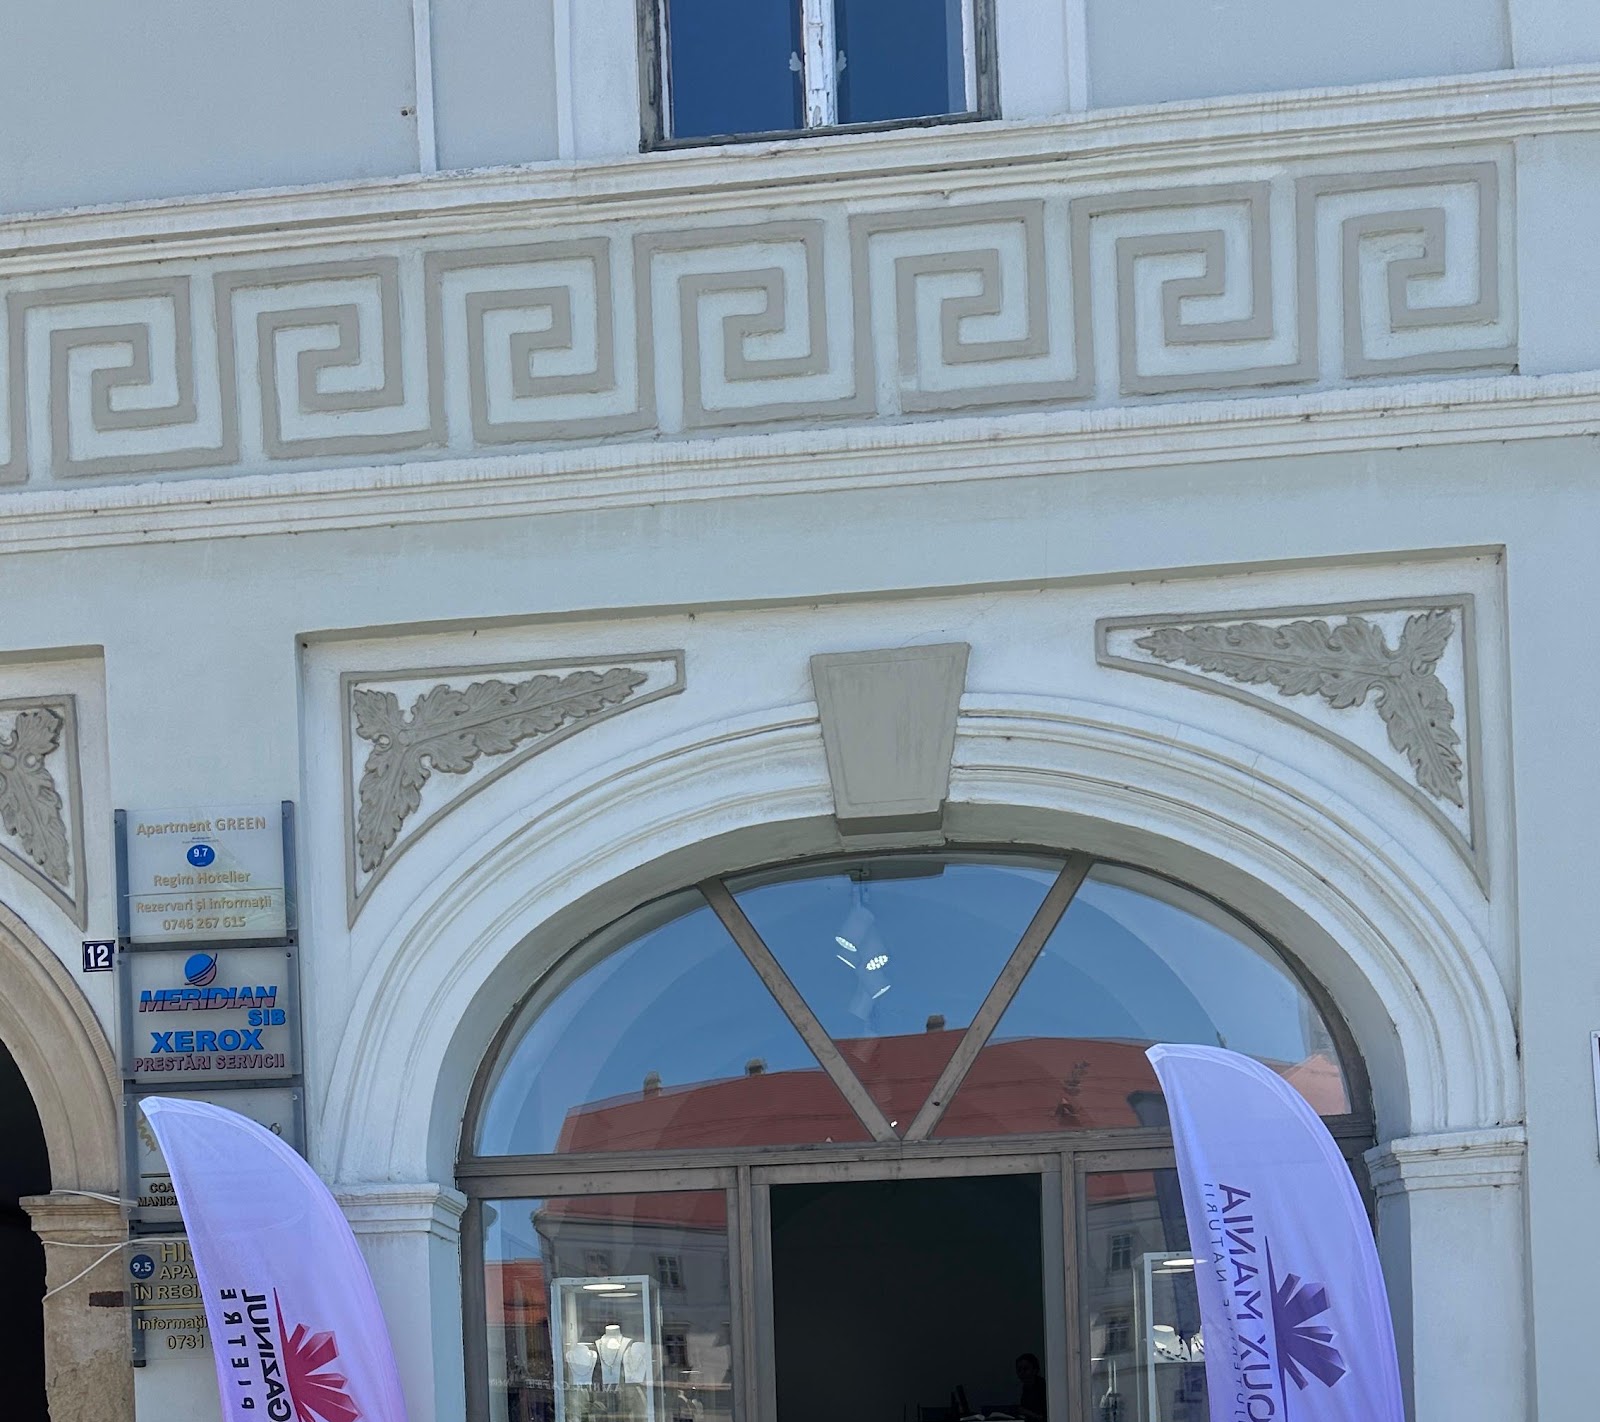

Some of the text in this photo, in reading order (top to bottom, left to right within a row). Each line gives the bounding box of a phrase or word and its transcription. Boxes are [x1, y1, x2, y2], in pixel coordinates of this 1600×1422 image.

[136, 817, 266, 838] Apartment GREEN
[193, 847, 209, 858] 9.7
[153, 871, 251, 888] Regim Hotelier
[136, 899, 193, 913] Rezervari
[162, 917, 194, 931] 0746
[223, 915, 246, 928] 615
[87, 944, 110, 968] 12
[138, 985, 278, 1012] MERIDIAN
[247, 1008, 287, 1027] SIB
[150, 1028, 265, 1053] XEROX
[133, 1052, 285, 1072] PRESTĂRI SERVICII
[161, 1242, 194, 1263] HI
[132, 1262, 152, 1273] 9.5
[160, 1264, 198, 1280] APA
[133, 1283, 203, 1300] ÎN REGI
